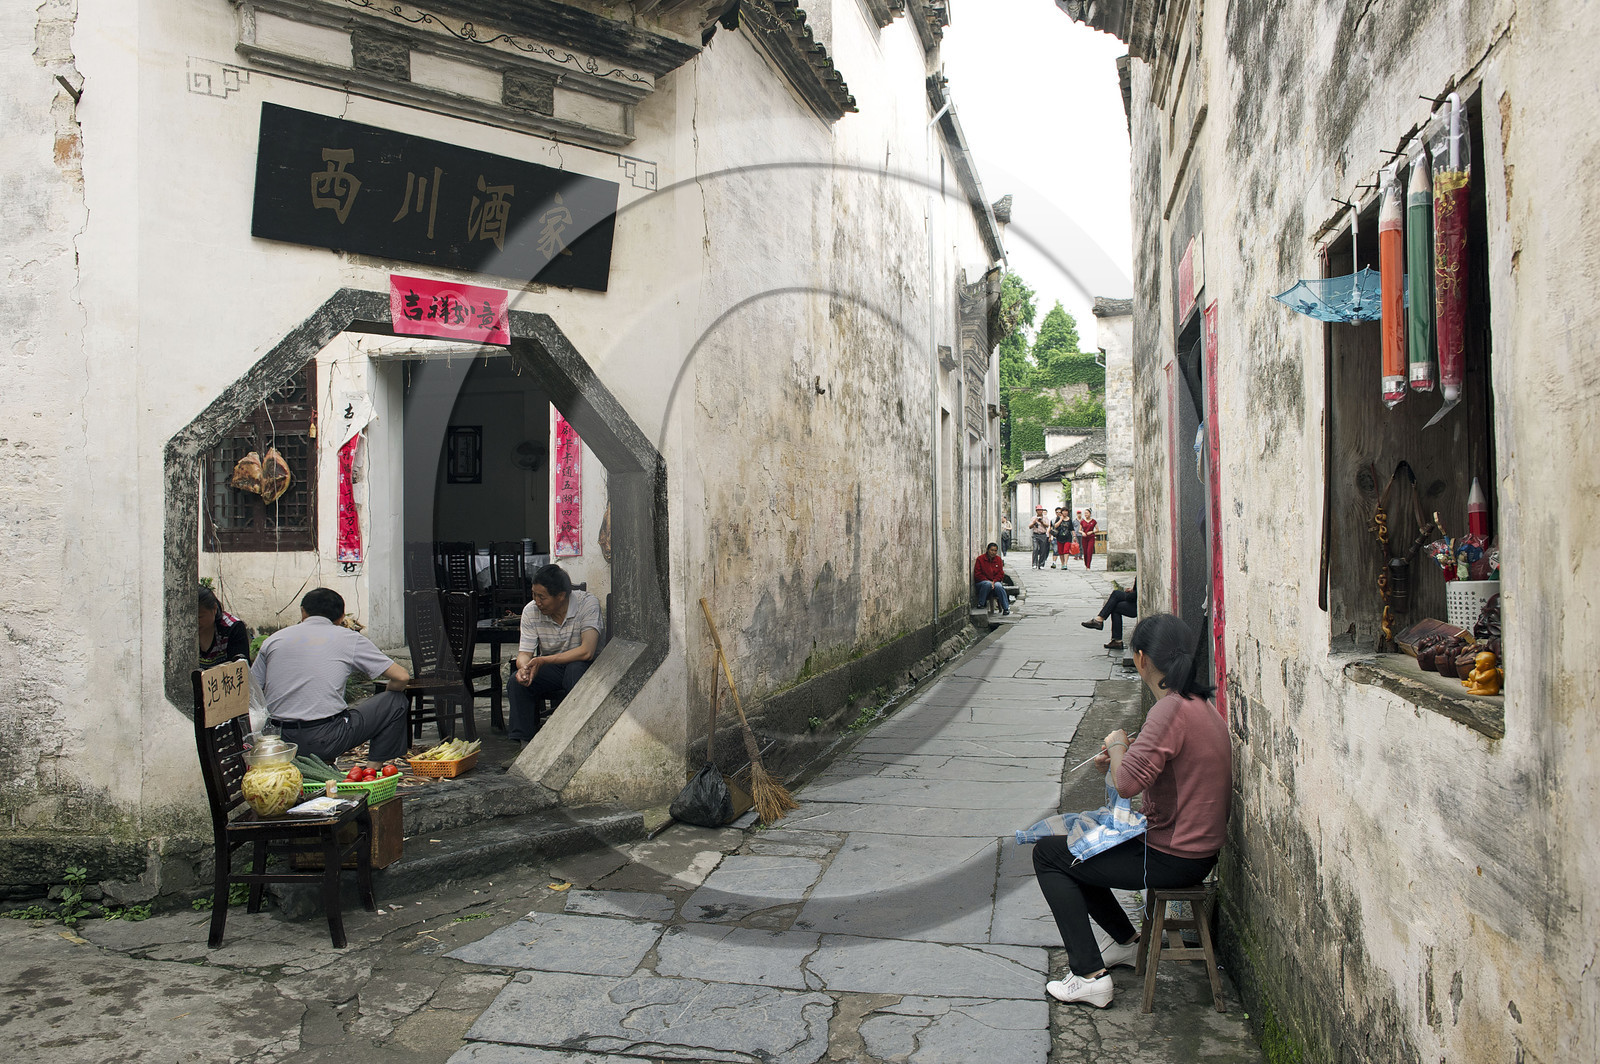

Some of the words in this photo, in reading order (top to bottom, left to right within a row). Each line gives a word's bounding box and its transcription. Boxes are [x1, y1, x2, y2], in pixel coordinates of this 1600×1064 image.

[309, 147, 574, 259] 西川酒家
[403, 288, 501, 331] 吉祥如意
[561, 417, 575, 533] 刷卡卡通五湖四海
